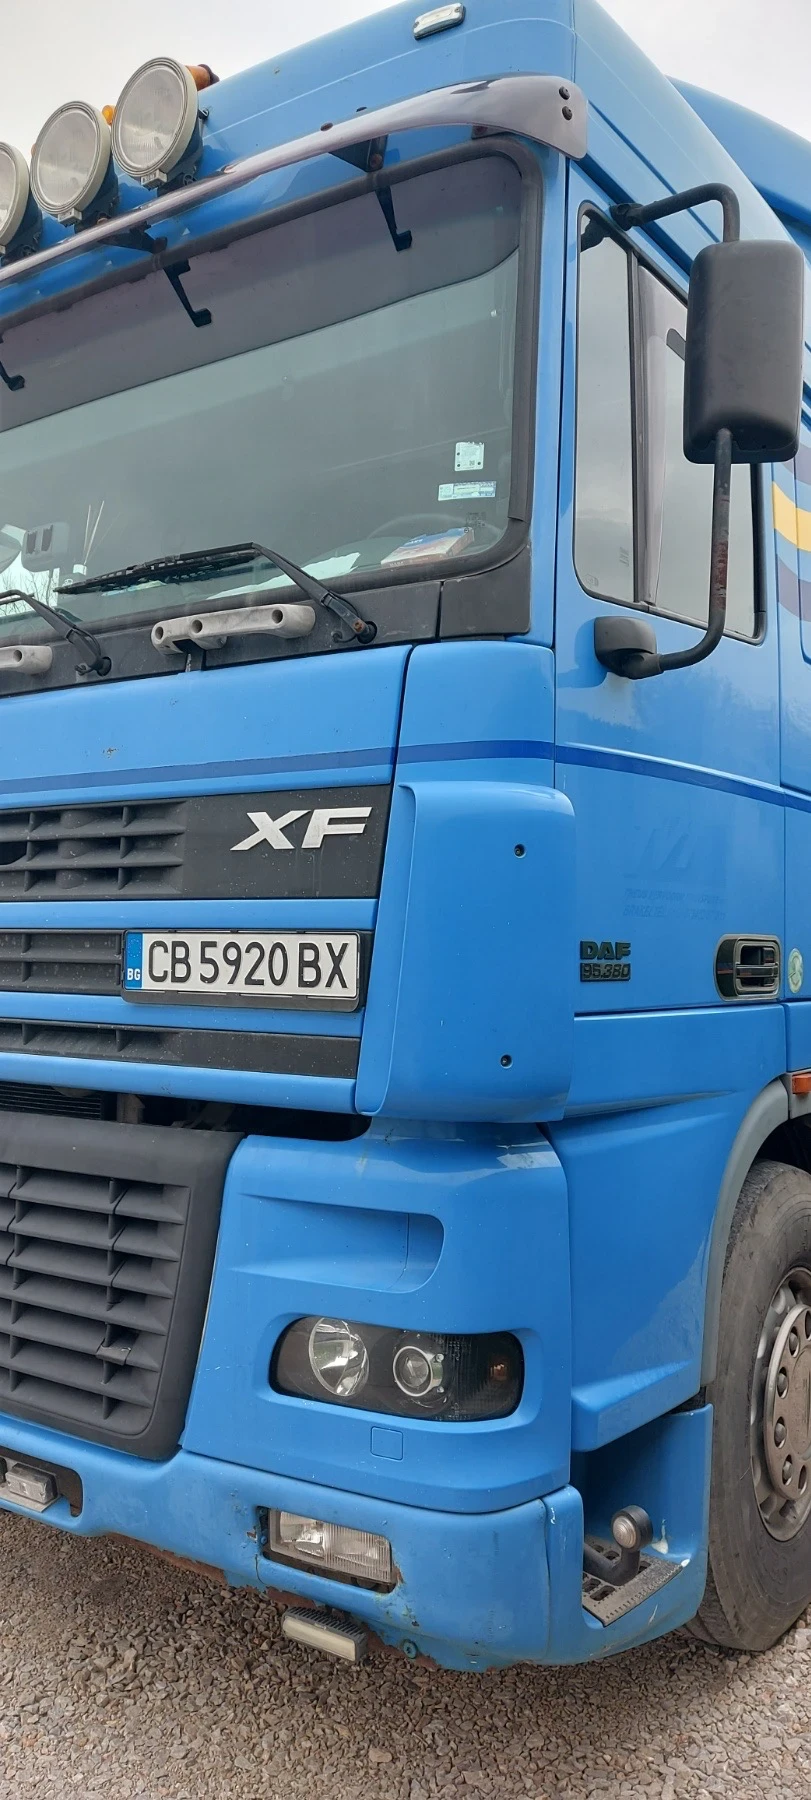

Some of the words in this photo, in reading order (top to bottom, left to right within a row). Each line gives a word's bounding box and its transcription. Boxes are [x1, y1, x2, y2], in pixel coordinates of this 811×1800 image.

[230, 807, 372, 850] XF
[580, 941, 631, 960] DAF
[127, 968, 140, 980] BG
[148, 940, 191, 983] CB
[199, 940, 288, 986] 5920
[298, 942, 349, 989] BX
[582, 963, 630, 979] 95.380
